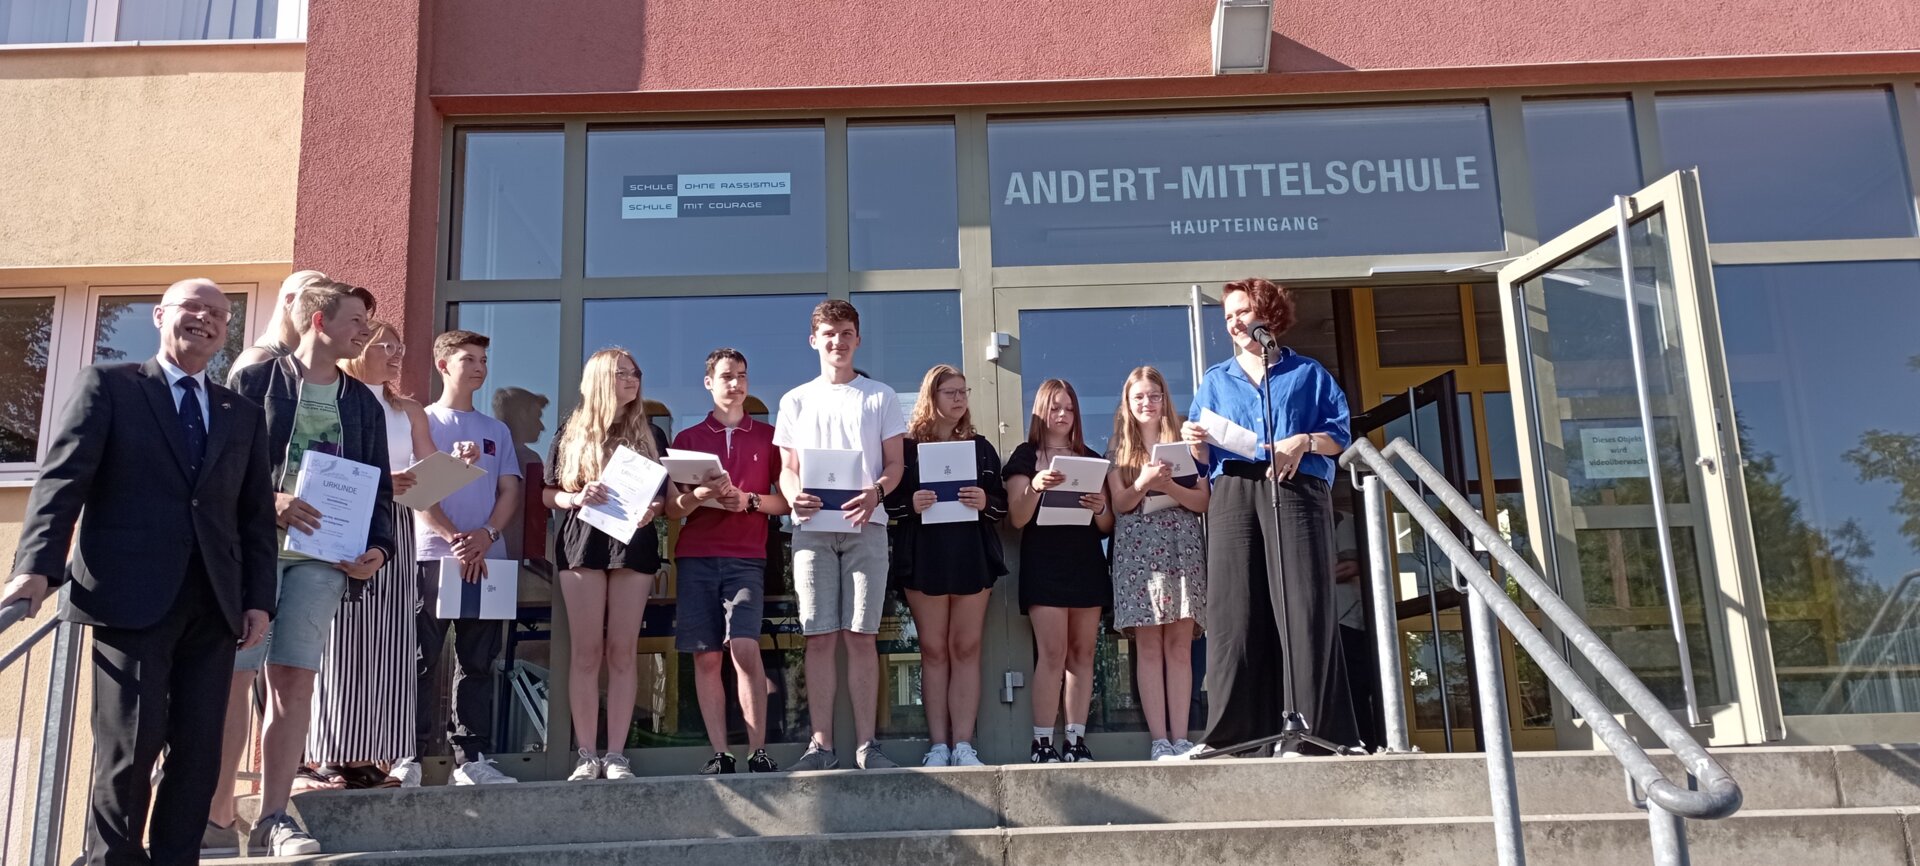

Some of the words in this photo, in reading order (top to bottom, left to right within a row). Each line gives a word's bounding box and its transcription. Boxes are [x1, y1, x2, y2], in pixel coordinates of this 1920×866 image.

[1004, 156, 1480, 205] ANDERT-MITTELSCHULE
[629, 183, 674, 191] SCHULE
[684, 182, 716, 190] OHNE
[720, 181, 786, 189] RASSISMUS
[628, 203, 672, 211] SCHULE
[683, 202, 704, 210] MIT
[708, 201, 762, 209] COURAGE
[1170, 216, 1319, 235] HAUPTEINGANG
[1592, 436, 1616, 444] Dieses
[1617, 435, 1642, 444] Objekt
[1610, 446, 1627, 454] wird
[323, 480, 358, 495] URKUNDE
